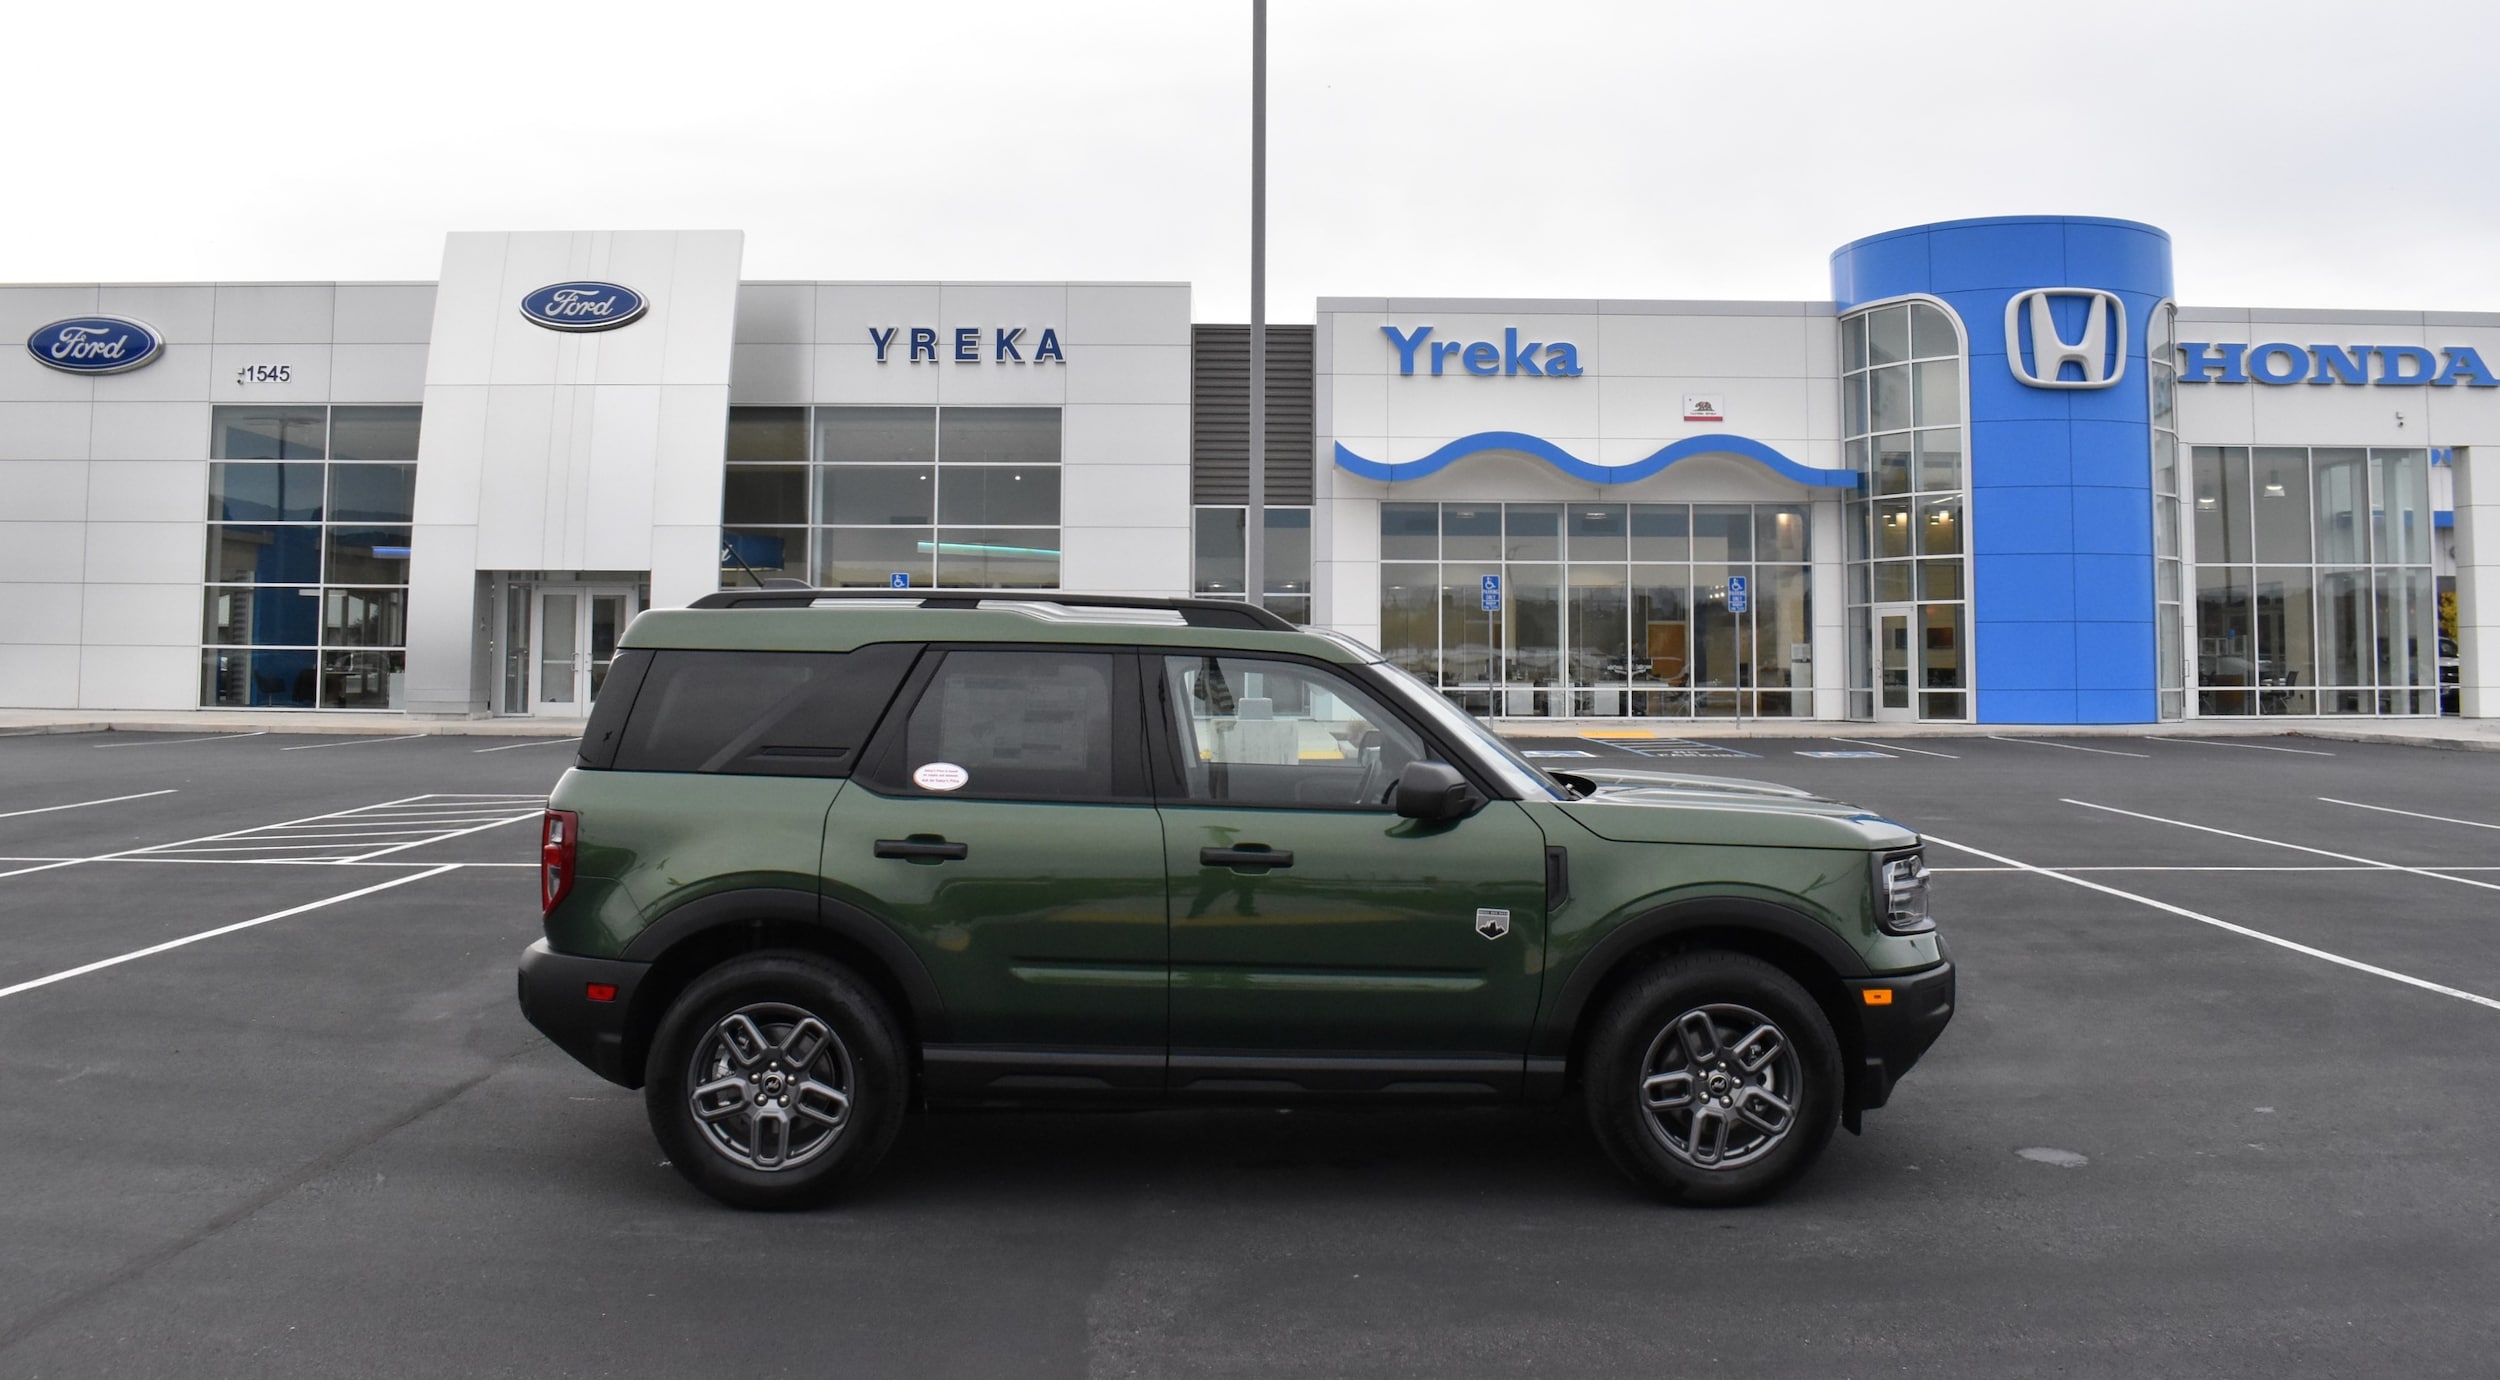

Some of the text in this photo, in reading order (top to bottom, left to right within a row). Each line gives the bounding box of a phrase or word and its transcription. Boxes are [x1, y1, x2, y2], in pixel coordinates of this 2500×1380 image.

[545, 289, 616, 316] Ford
[51, 326, 127, 359] Ford
[868, 327, 1067, 363] YREKA
[1380, 326, 1584, 377] Yreka
[246, 366, 290, 382] 1545
[2177, 342, 2500, 387] HONDA
